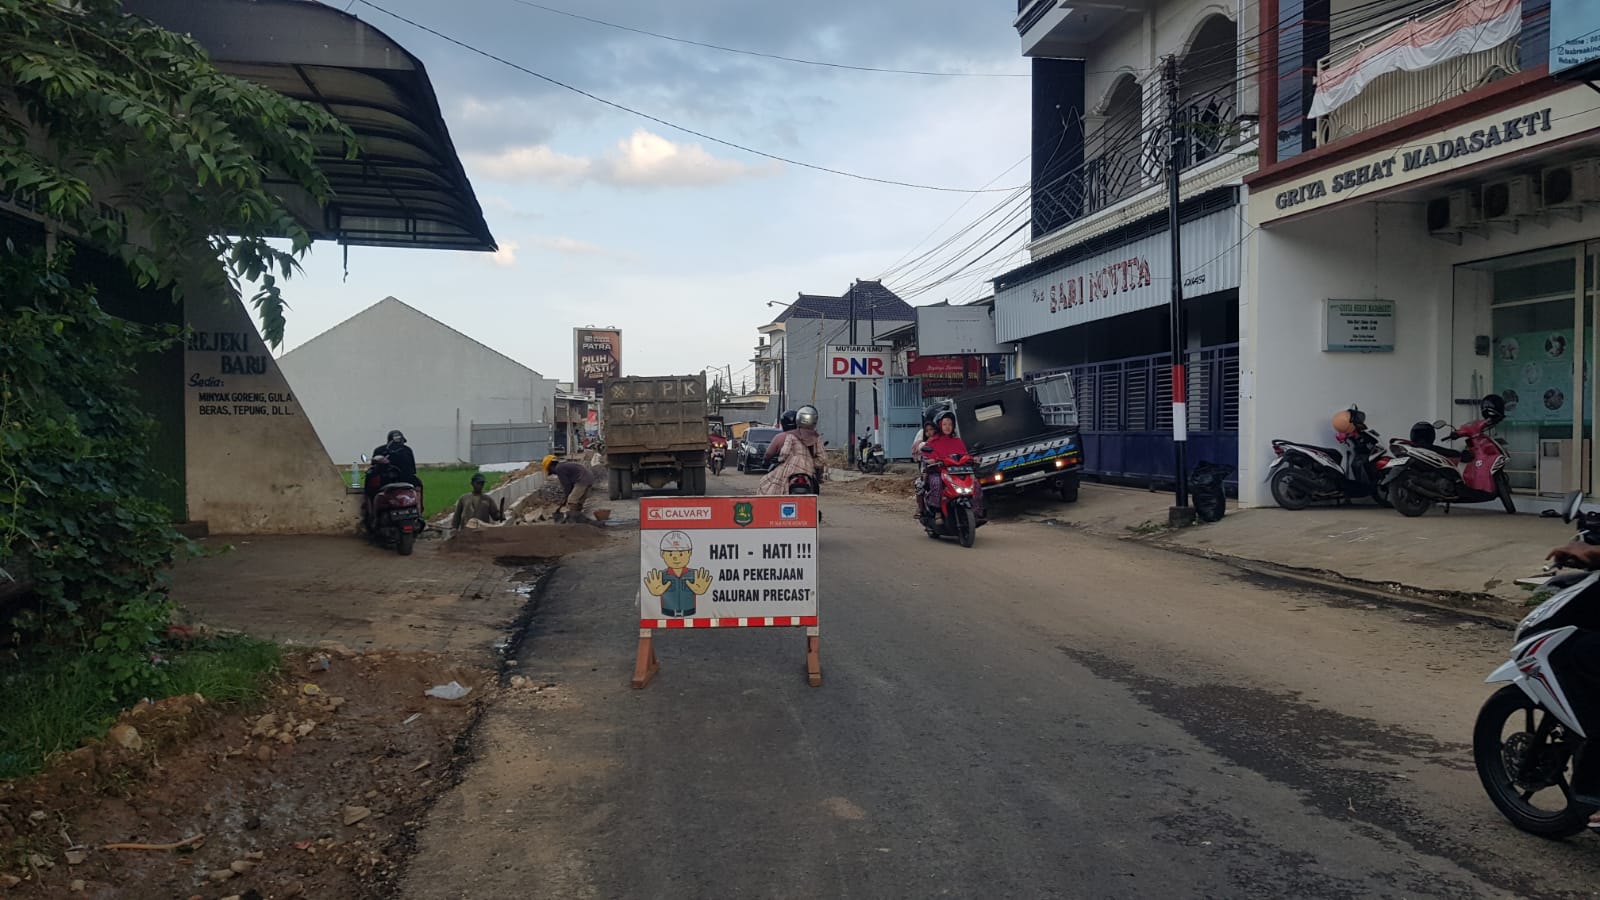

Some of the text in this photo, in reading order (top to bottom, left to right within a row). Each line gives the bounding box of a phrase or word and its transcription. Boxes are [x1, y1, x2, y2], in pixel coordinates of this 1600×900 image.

[1275, 107, 1552, 210] GRIYA SEHAT MADASAKTI
[187, 332, 249, 352] REJEKI
[221, 355, 267, 375] BARU
[581, 355, 607, 364] PILIH
[832, 357, 885, 376] DNR
[199, 392, 293, 403] MINYAK GORENG, GULA
[199, 405, 232, 416] BERAS,
[233, 405, 269, 416] TEPUNG,
[980, 437, 1071, 468] SOUND
[665, 508, 710, 518] CALVARY
[709, 543, 739, 560] HATI
[762, 543, 792, 559] HATI
[718, 567, 804, 581] ADA PEKERJAAN
[712, 588, 811, 602] SALURAN PRECAST
